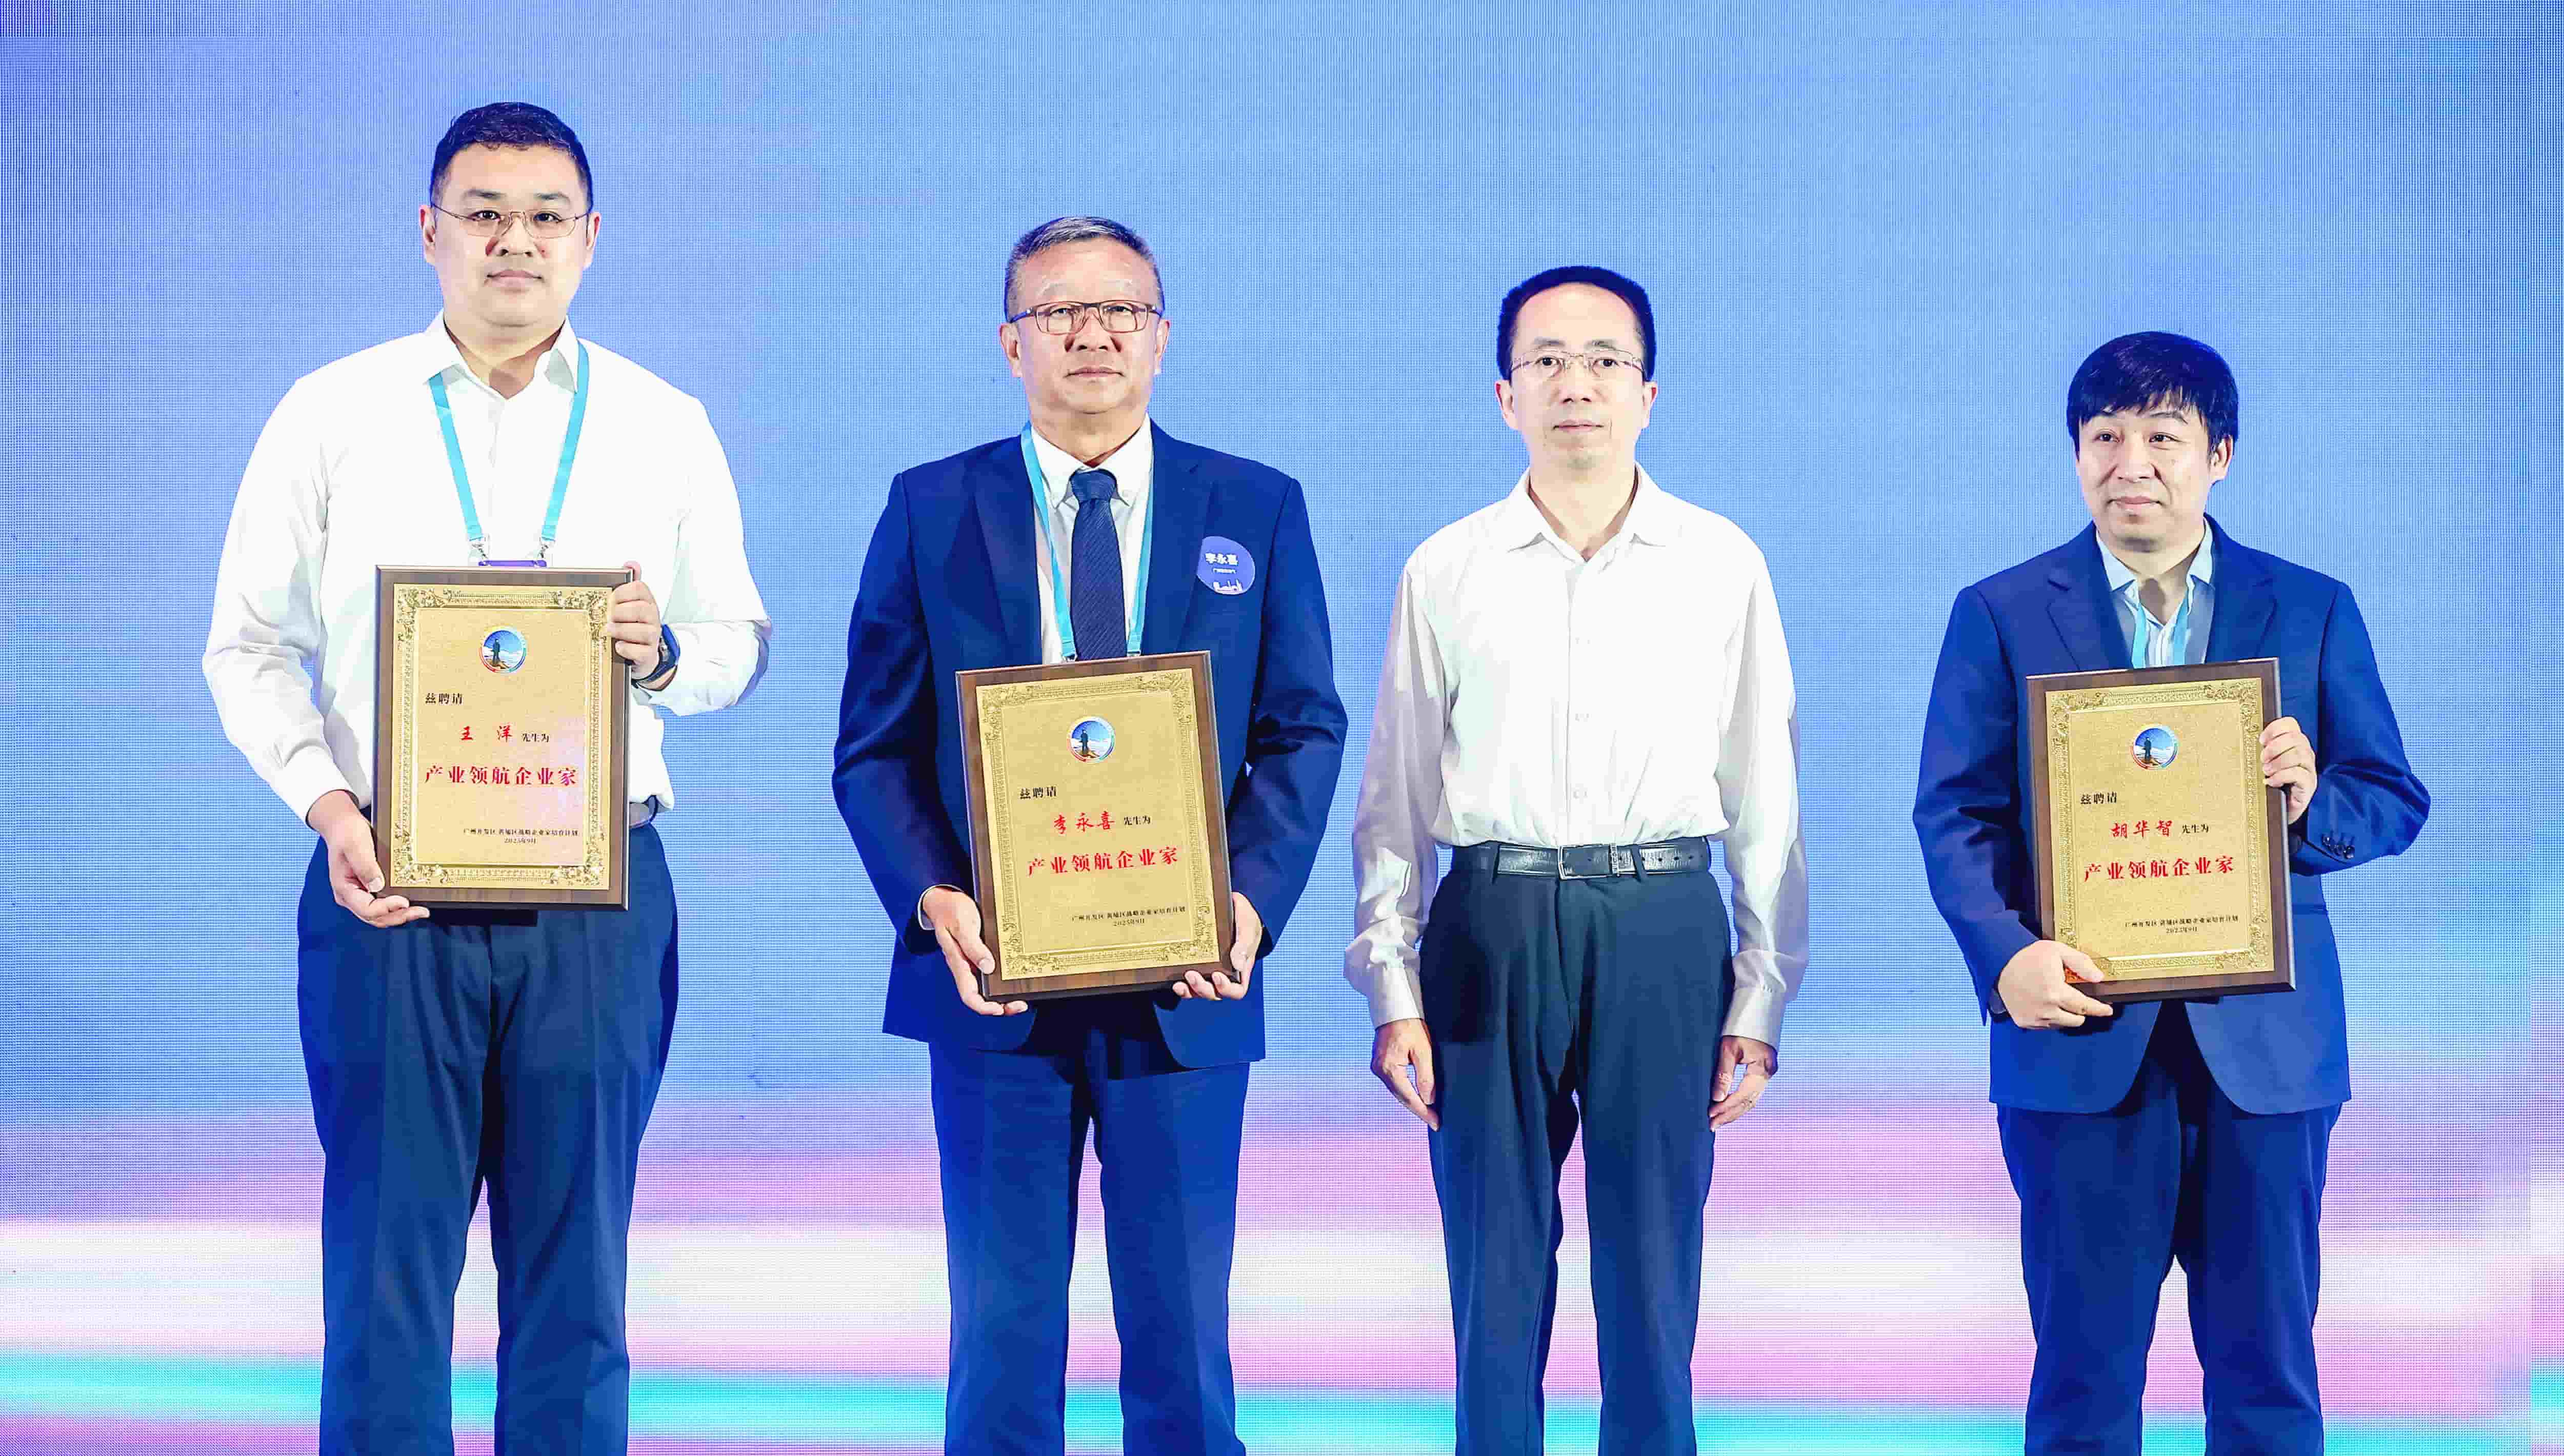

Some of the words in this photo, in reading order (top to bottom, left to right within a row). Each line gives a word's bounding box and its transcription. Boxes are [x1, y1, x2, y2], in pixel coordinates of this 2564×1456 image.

[425, 693, 463, 704] 兹聘请
[461, 725, 473, 741] 王
[496, 724, 512, 742] 洋
[522, 733, 550, 742] 先生为
[425, 764, 577, 787] 产业领航企业家
[1020, 786, 1057, 800] 兹聘请
[2080, 791, 2118, 805] 兹聘请
[1053, 811, 1115, 835] 李永喜
[1124, 816, 1151, 825] 先生为
[2110, 820, 2173, 839] 胡华智
[2181, 823, 2210, 834] 先生为
[1027, 846, 1178, 877] 产业领航企业家
[2084, 855, 2235, 882] 产业领航企业家
